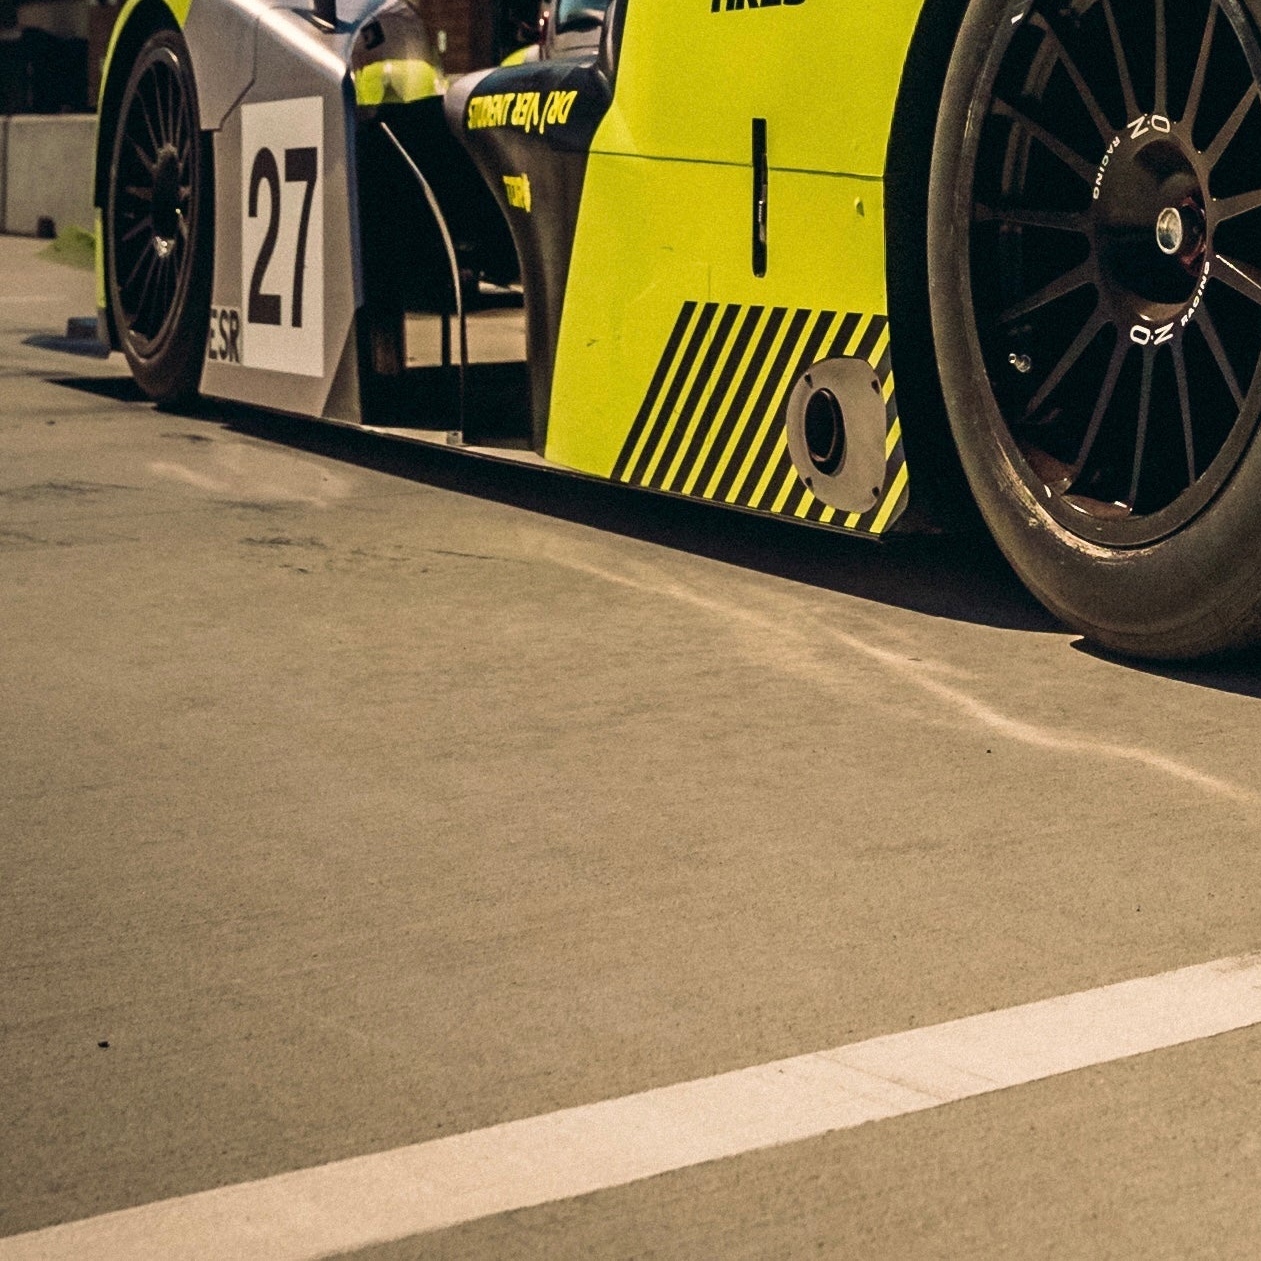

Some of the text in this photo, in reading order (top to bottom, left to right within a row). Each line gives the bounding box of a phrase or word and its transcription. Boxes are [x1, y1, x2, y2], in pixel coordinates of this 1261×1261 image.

[1092, 135, 1120, 200] RACING
[247, 146, 318, 328] 27
[1181, 260, 1211, 327] RACING
